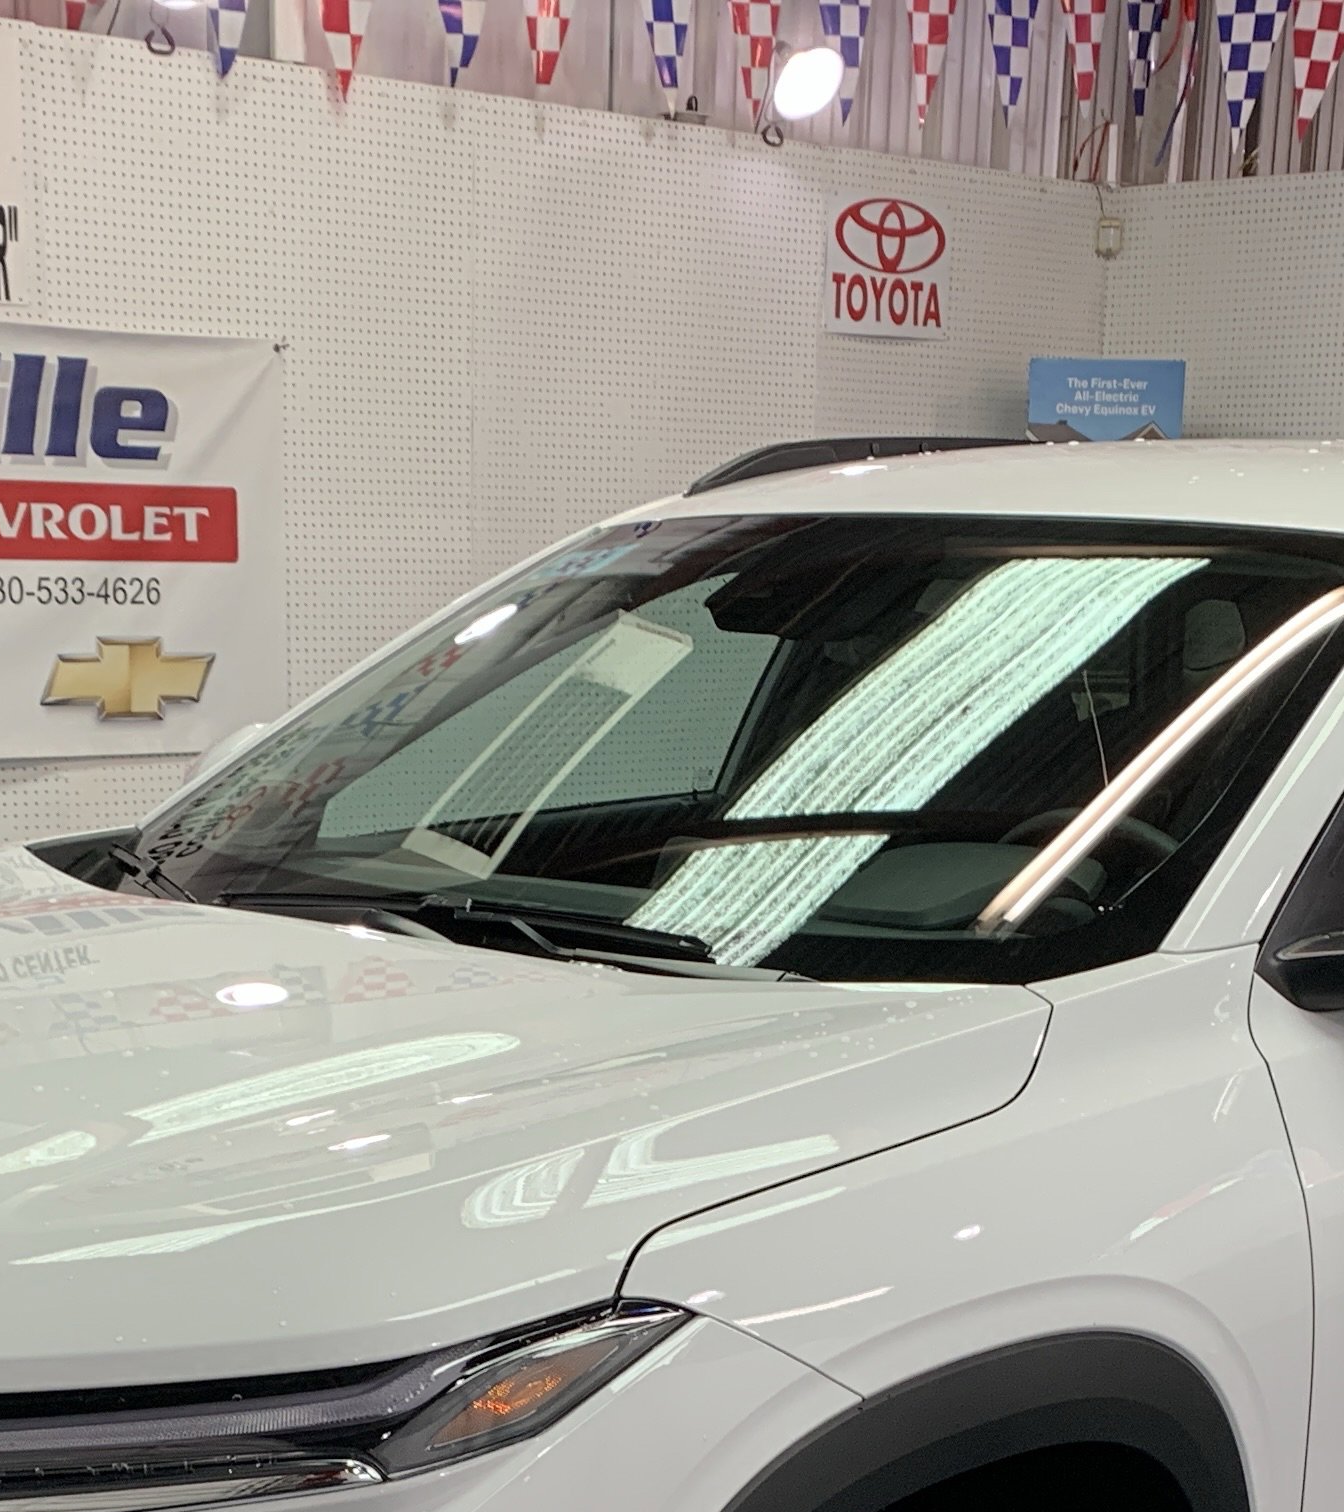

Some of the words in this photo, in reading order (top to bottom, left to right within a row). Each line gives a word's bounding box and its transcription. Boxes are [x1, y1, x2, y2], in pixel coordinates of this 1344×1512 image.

[832, 273, 942, 328] TOYOTA
[1067, 377, 1088, 389] The
[1090, 377, 1149, 390] First-Ever
[1074, 390, 1140, 402] All-Electric
[1056, 403, 1092, 416] Chevy
[1093, 404, 1139, 416] Equinox
[1140, 405, 1156, 416] EV
